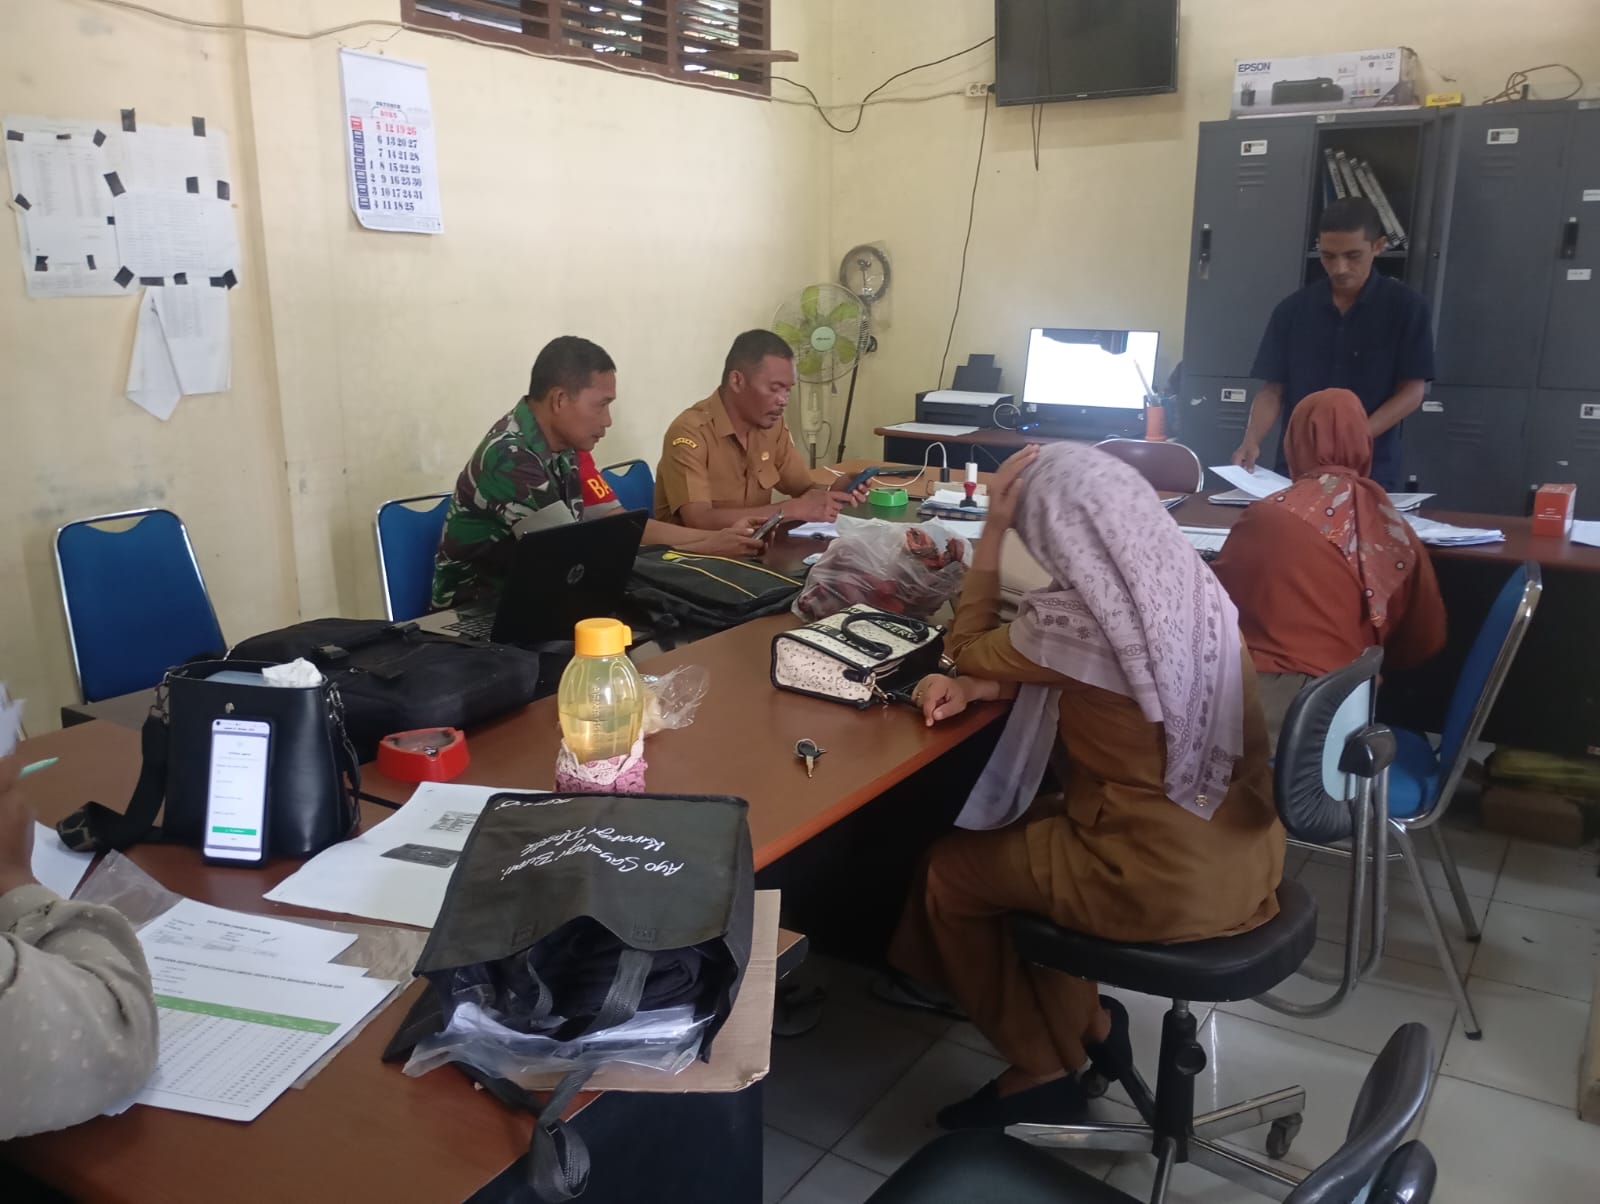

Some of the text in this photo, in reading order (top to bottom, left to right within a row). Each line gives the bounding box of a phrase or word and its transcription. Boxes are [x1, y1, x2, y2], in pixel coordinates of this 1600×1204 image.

[1238, 62, 1271, 73] EPSON
[385, 123, 394, 133] 12
[396, 125, 405, 134] 19
[406, 126, 417, 136] 26
[386, 136, 396, 146] 13
[397, 136, 407, 147] 20
[408, 138, 418, 149] 27
[388, 149, 397, 159] 14
[398, 150, 408, 160] 21
[409, 152, 420, 161] 28
[389, 162, 398, 172] 15
[400, 164, 409, 173] 22
[410, 165, 421, 174] 29
[390, 175, 400, 185] 16
[401, 176, 411, 186] 23
[412, 177, 422, 187] 30
[381, 187, 391, 197] 10
[392, 188, 401, 198] 17
[402, 189, 412, 199] 24
[413, 190, 423, 200] 31
[383, 200, 392, 210] 11
[394, 201, 404, 210] 18
[405, 202, 415, 211] 25
[586, 827, 666, 852] Kurangi
[644, 860, 685, 876] Ayo
